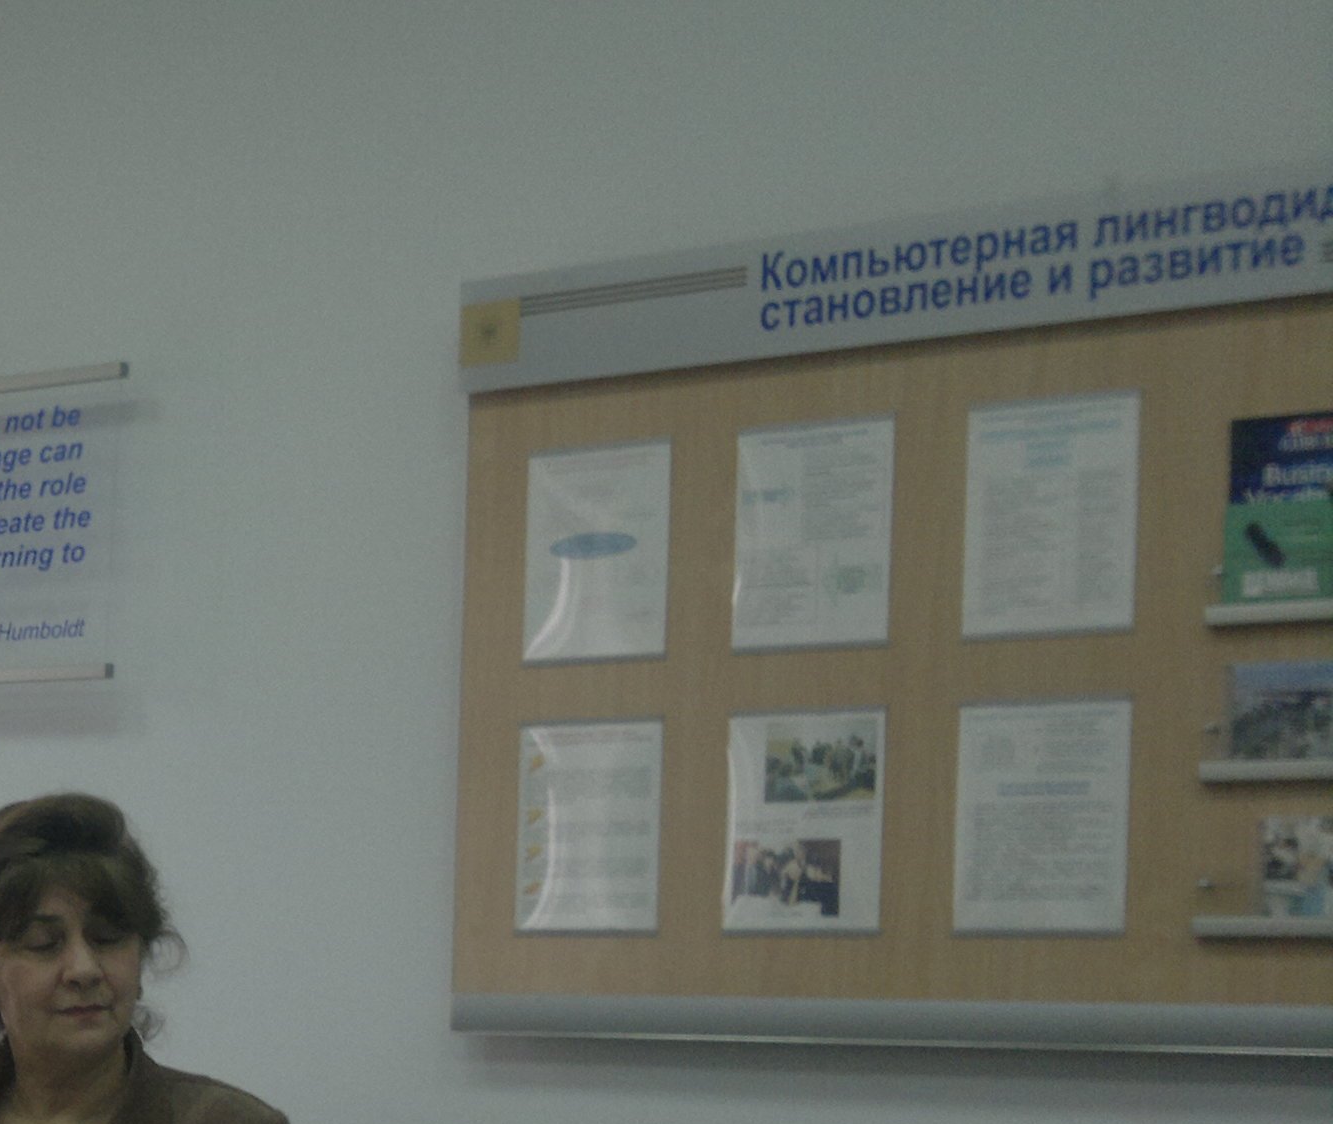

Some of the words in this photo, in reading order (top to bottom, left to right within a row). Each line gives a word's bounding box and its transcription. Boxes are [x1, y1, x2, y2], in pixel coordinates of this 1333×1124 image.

[760, 219, 1079, 292] Компьютерная
[759, 267, 1033, 332] становление
[1048, 263, 1073, 296] и
[1090, 234, 1306, 301] развитие
[4, 409, 45, 433] not
[52, 405, 82, 428] be
[39, 442, 83, 464] can
[39, 472, 87, 497] role
[52, 507, 92, 530] the
[62, 542, 86, 565] to
